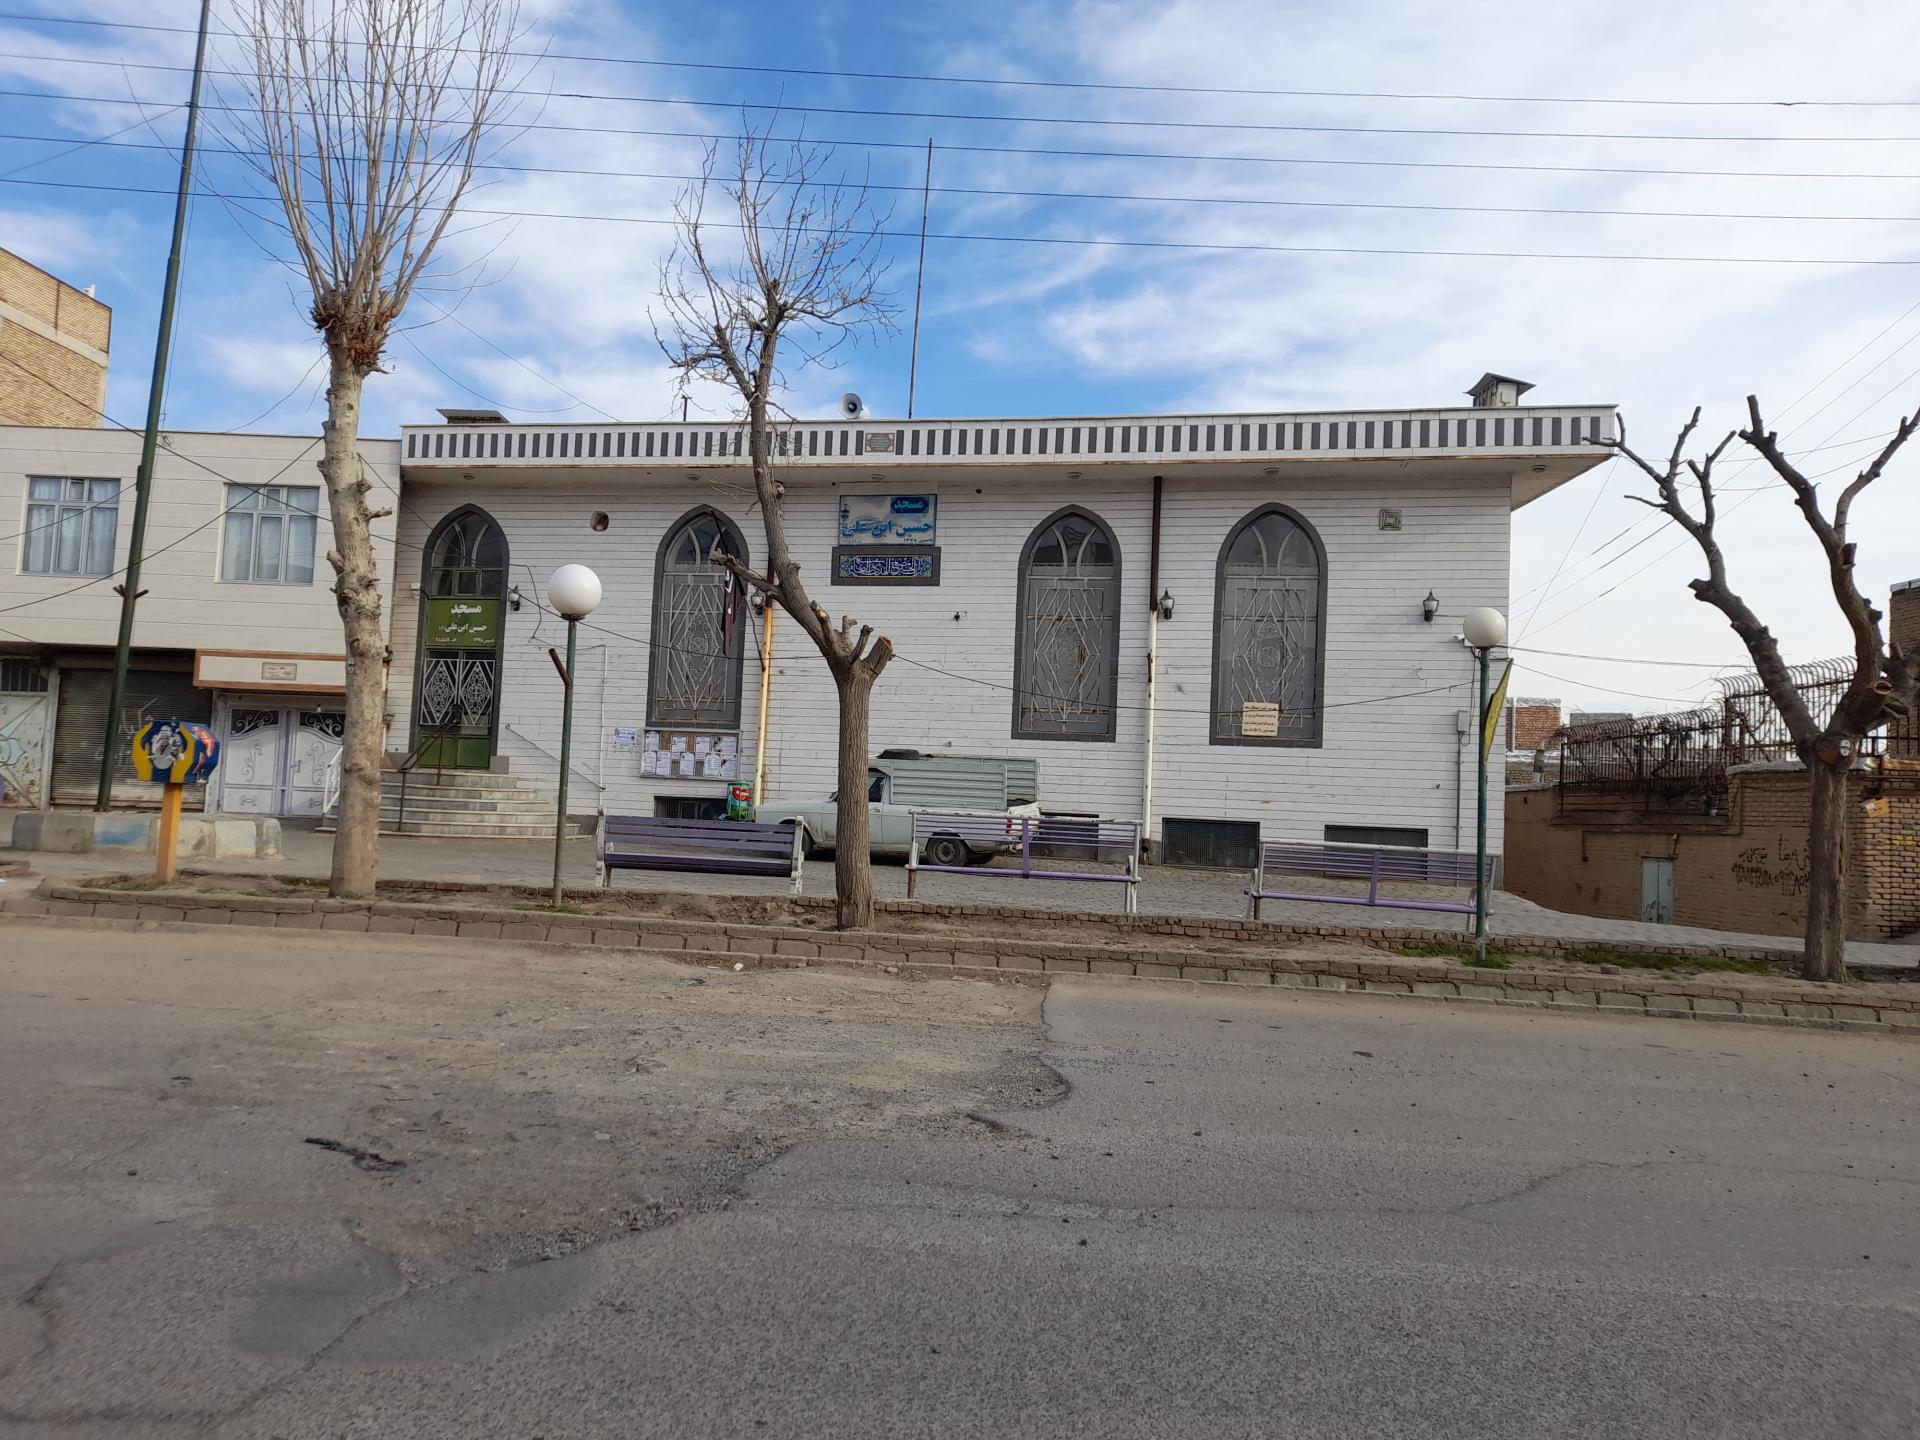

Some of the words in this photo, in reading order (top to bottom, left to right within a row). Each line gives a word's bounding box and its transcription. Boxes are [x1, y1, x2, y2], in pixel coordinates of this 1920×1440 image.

[894, 500, 924, 512] مسجد
[842, 520, 871, 538] علی
[872, 520, 892, 538] ابن
[896, 523, 933, 538] حسین
[451, 604, 482, 617] مسجد
[445, 623, 457, 632] علی
[457, 623, 468, 632] ابن
[469, 625, 487, 633] حسین
